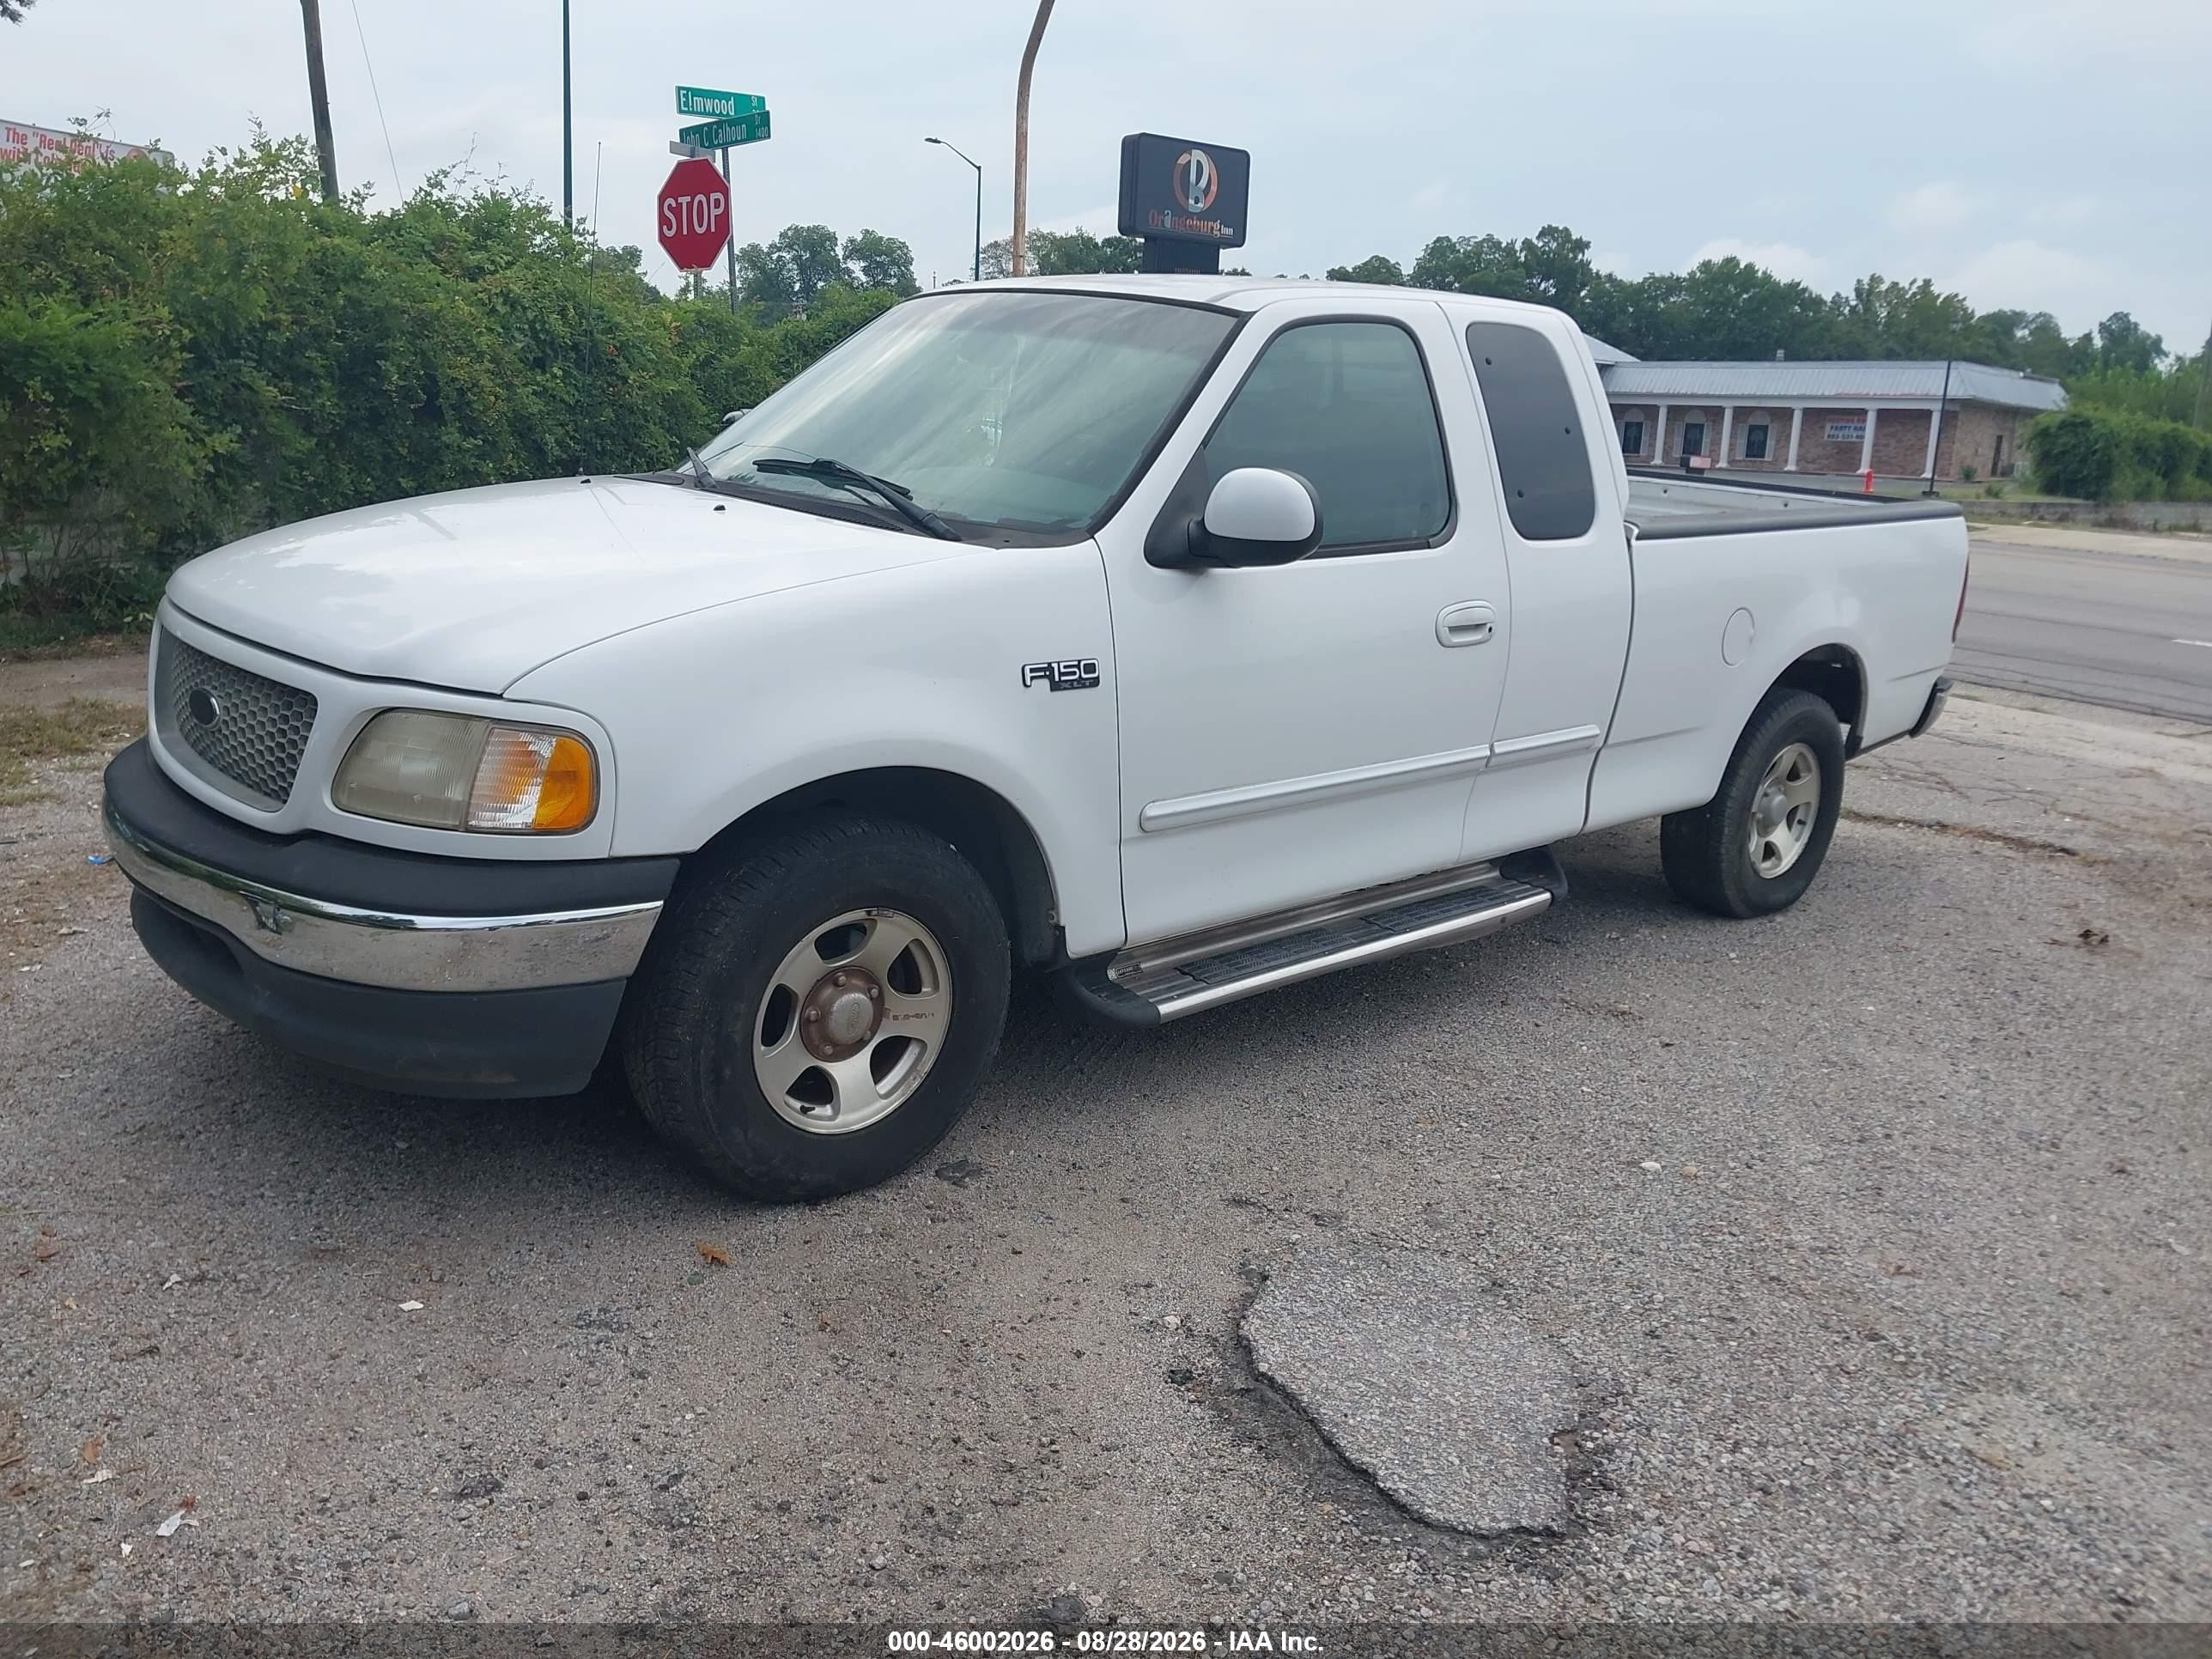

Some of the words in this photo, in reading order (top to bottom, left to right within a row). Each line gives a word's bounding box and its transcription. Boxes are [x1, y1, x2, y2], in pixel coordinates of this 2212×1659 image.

[679, 89, 735, 116] Elmwood
[5, 126, 28, 146] The
[683, 131, 701, 149] John
[703, 126, 709, 147] C
[712, 123, 747, 145] Calhoun
[662, 191, 726, 238] STOP
[1148, 210, 1221, 238] Orangeburg
[1220, 224, 1234, 236] Inn
